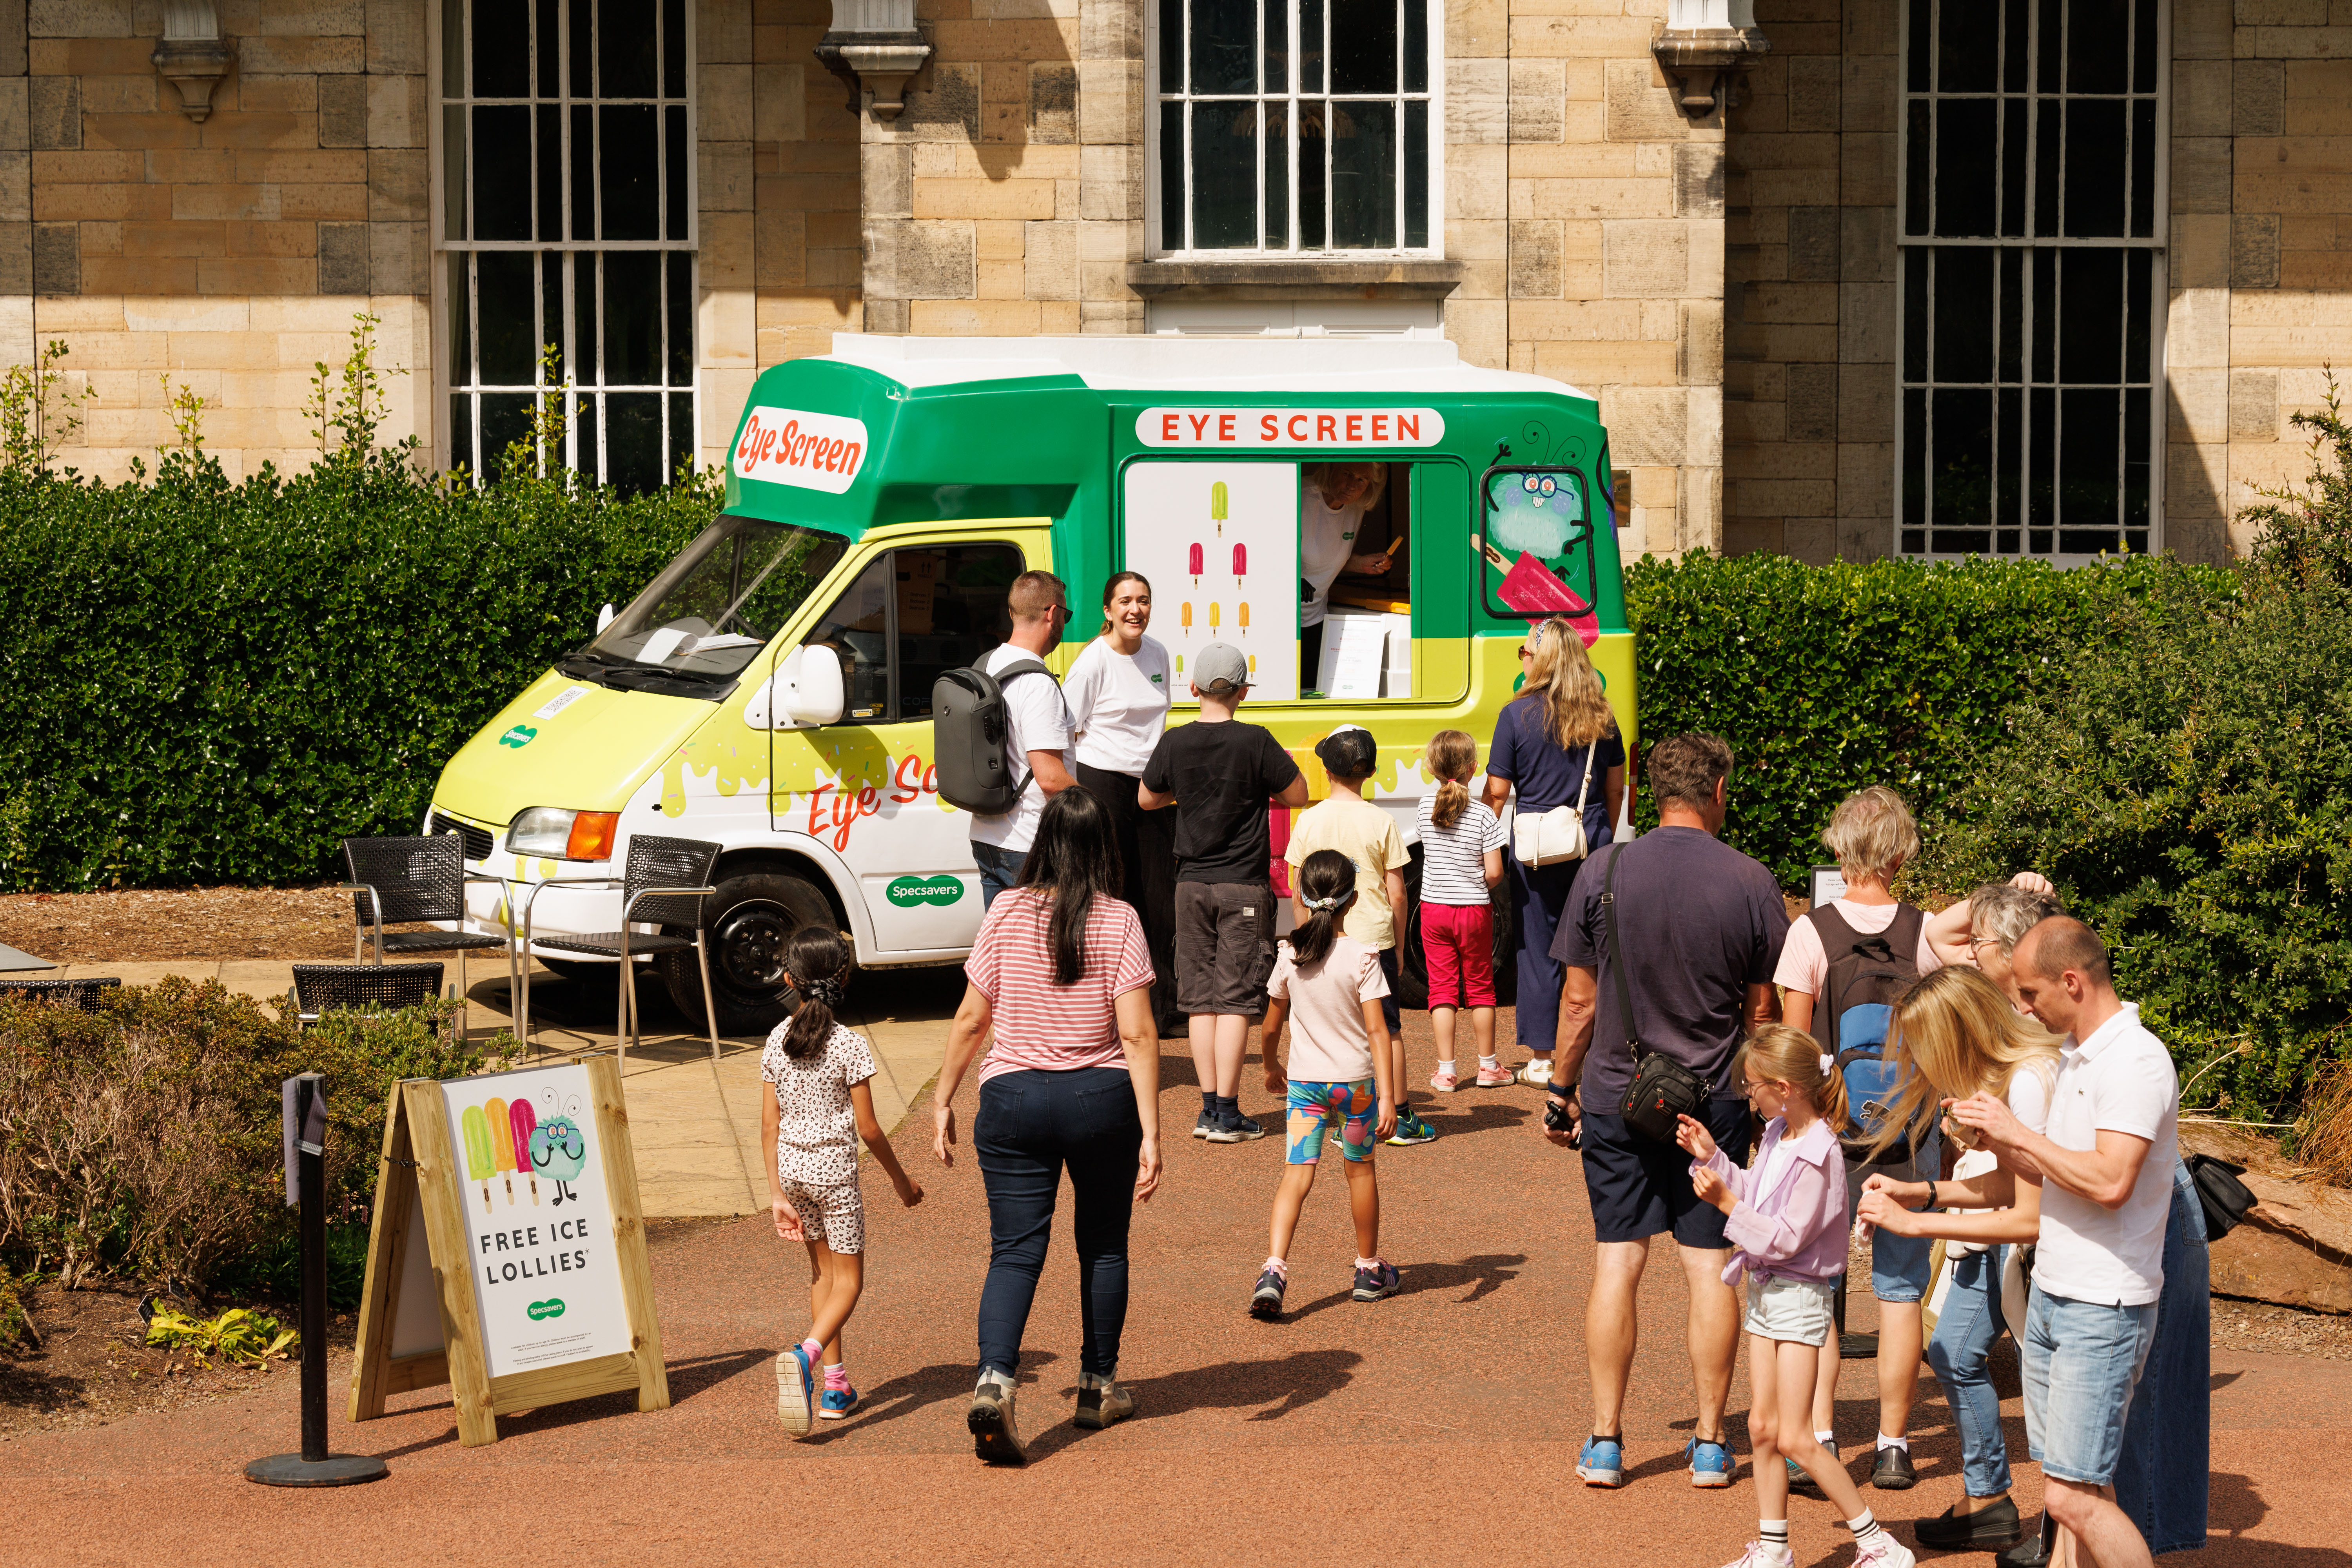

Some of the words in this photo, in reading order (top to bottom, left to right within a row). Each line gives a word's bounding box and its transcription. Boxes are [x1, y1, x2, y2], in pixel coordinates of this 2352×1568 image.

[1162, 414, 1237, 441] EYE
[1260, 414, 1420, 441] SCREEN
[737, 414, 777, 473] Eye
[777, 419, 861, 476] Screen
[505, 730, 531, 742] Specsavers
[808, 783, 881, 853] Eye
[893, 885, 958, 898] Specsavers
[481, 1227, 539, 1254] FREE
[551, 1218, 588, 1242] ICE
[530, 1304, 563, 1316] Specsavers
